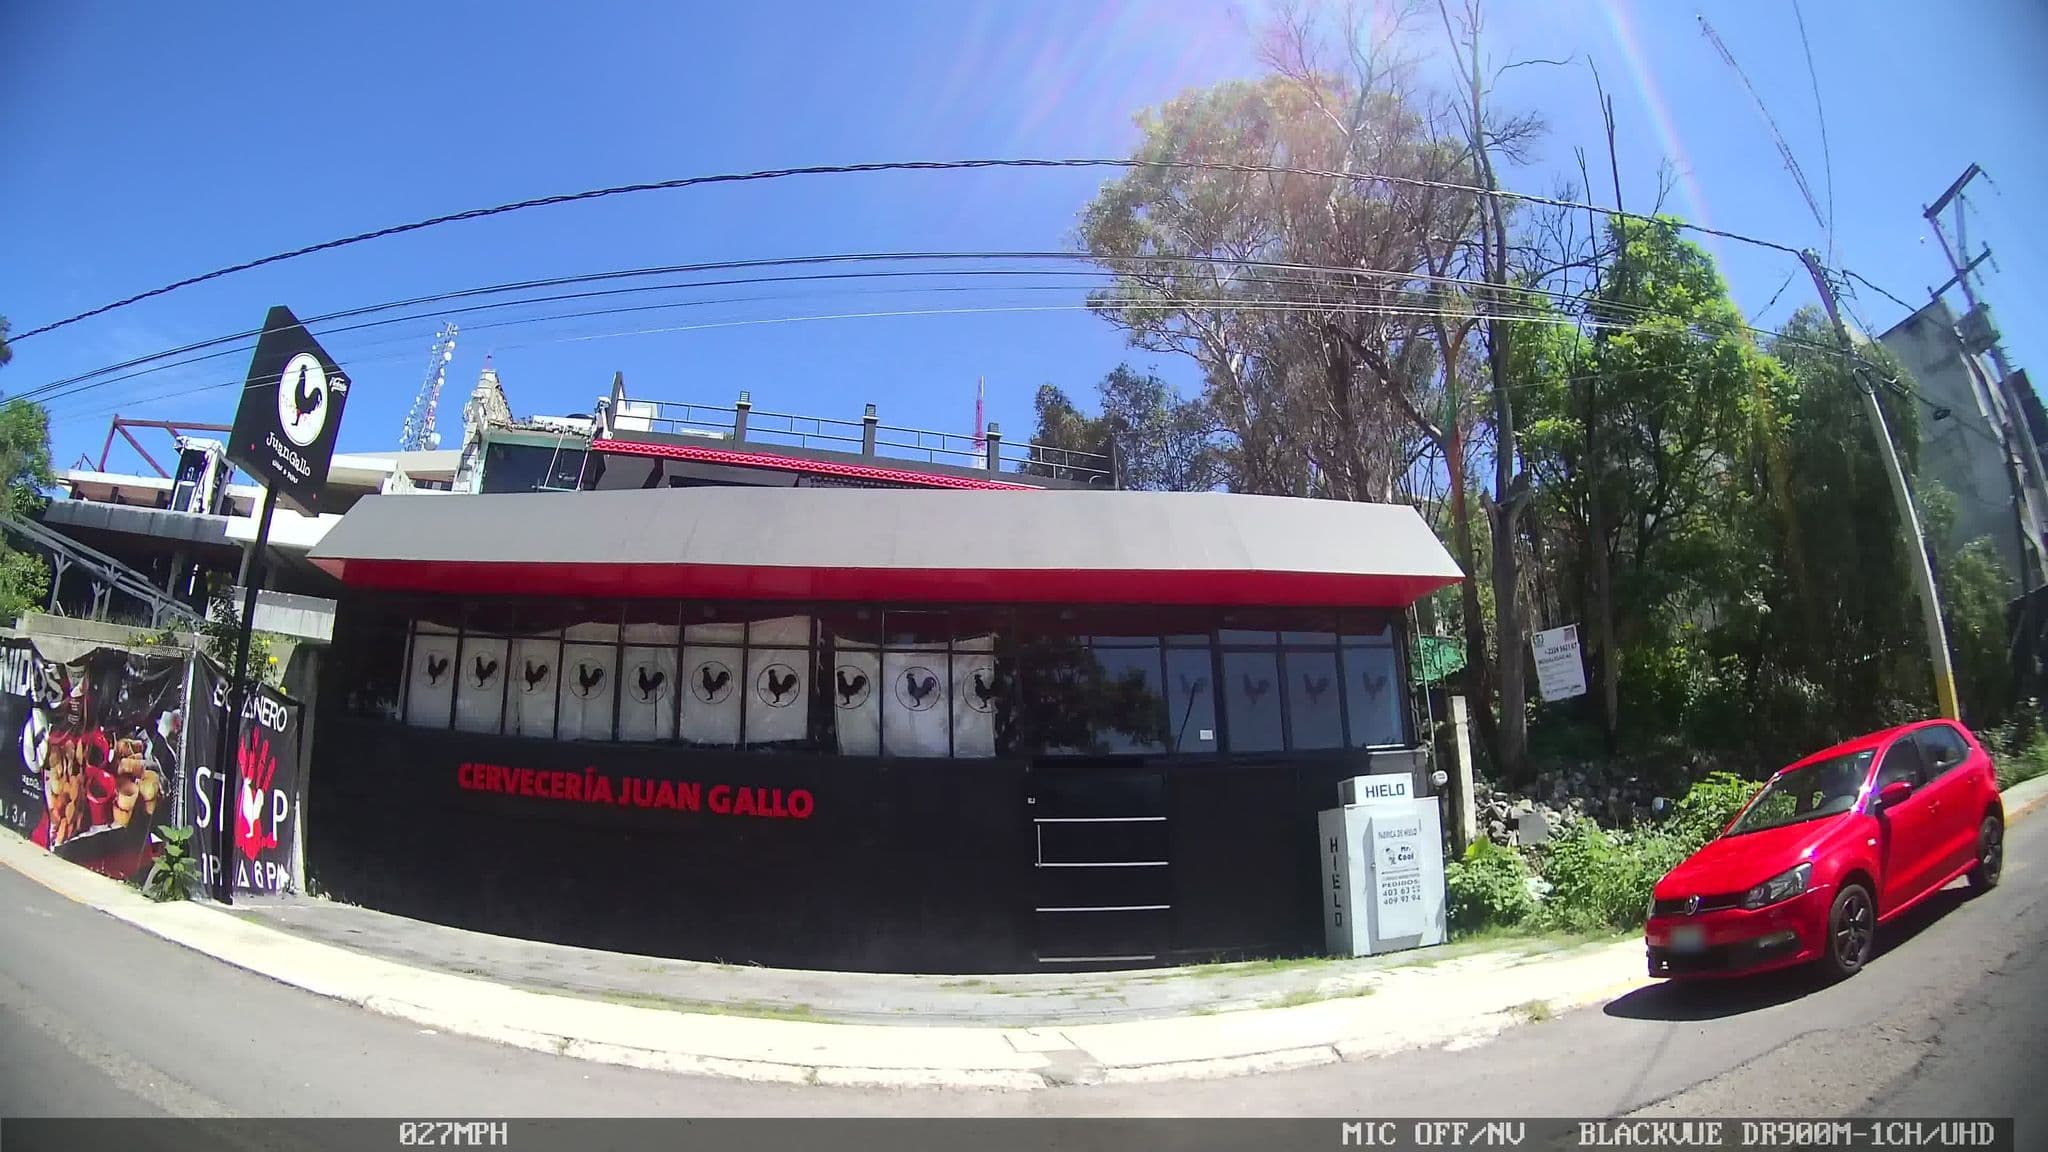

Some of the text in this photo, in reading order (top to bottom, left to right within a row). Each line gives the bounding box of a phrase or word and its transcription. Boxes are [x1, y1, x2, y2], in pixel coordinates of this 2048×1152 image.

[457, 763, 814, 818] CERVECERÍA JUAN GALLO
[1365, 783, 1405, 798] HIELO
[1398, 853, 1414, 861] Cool
[1330, 836, 1342, 928] HIELO
